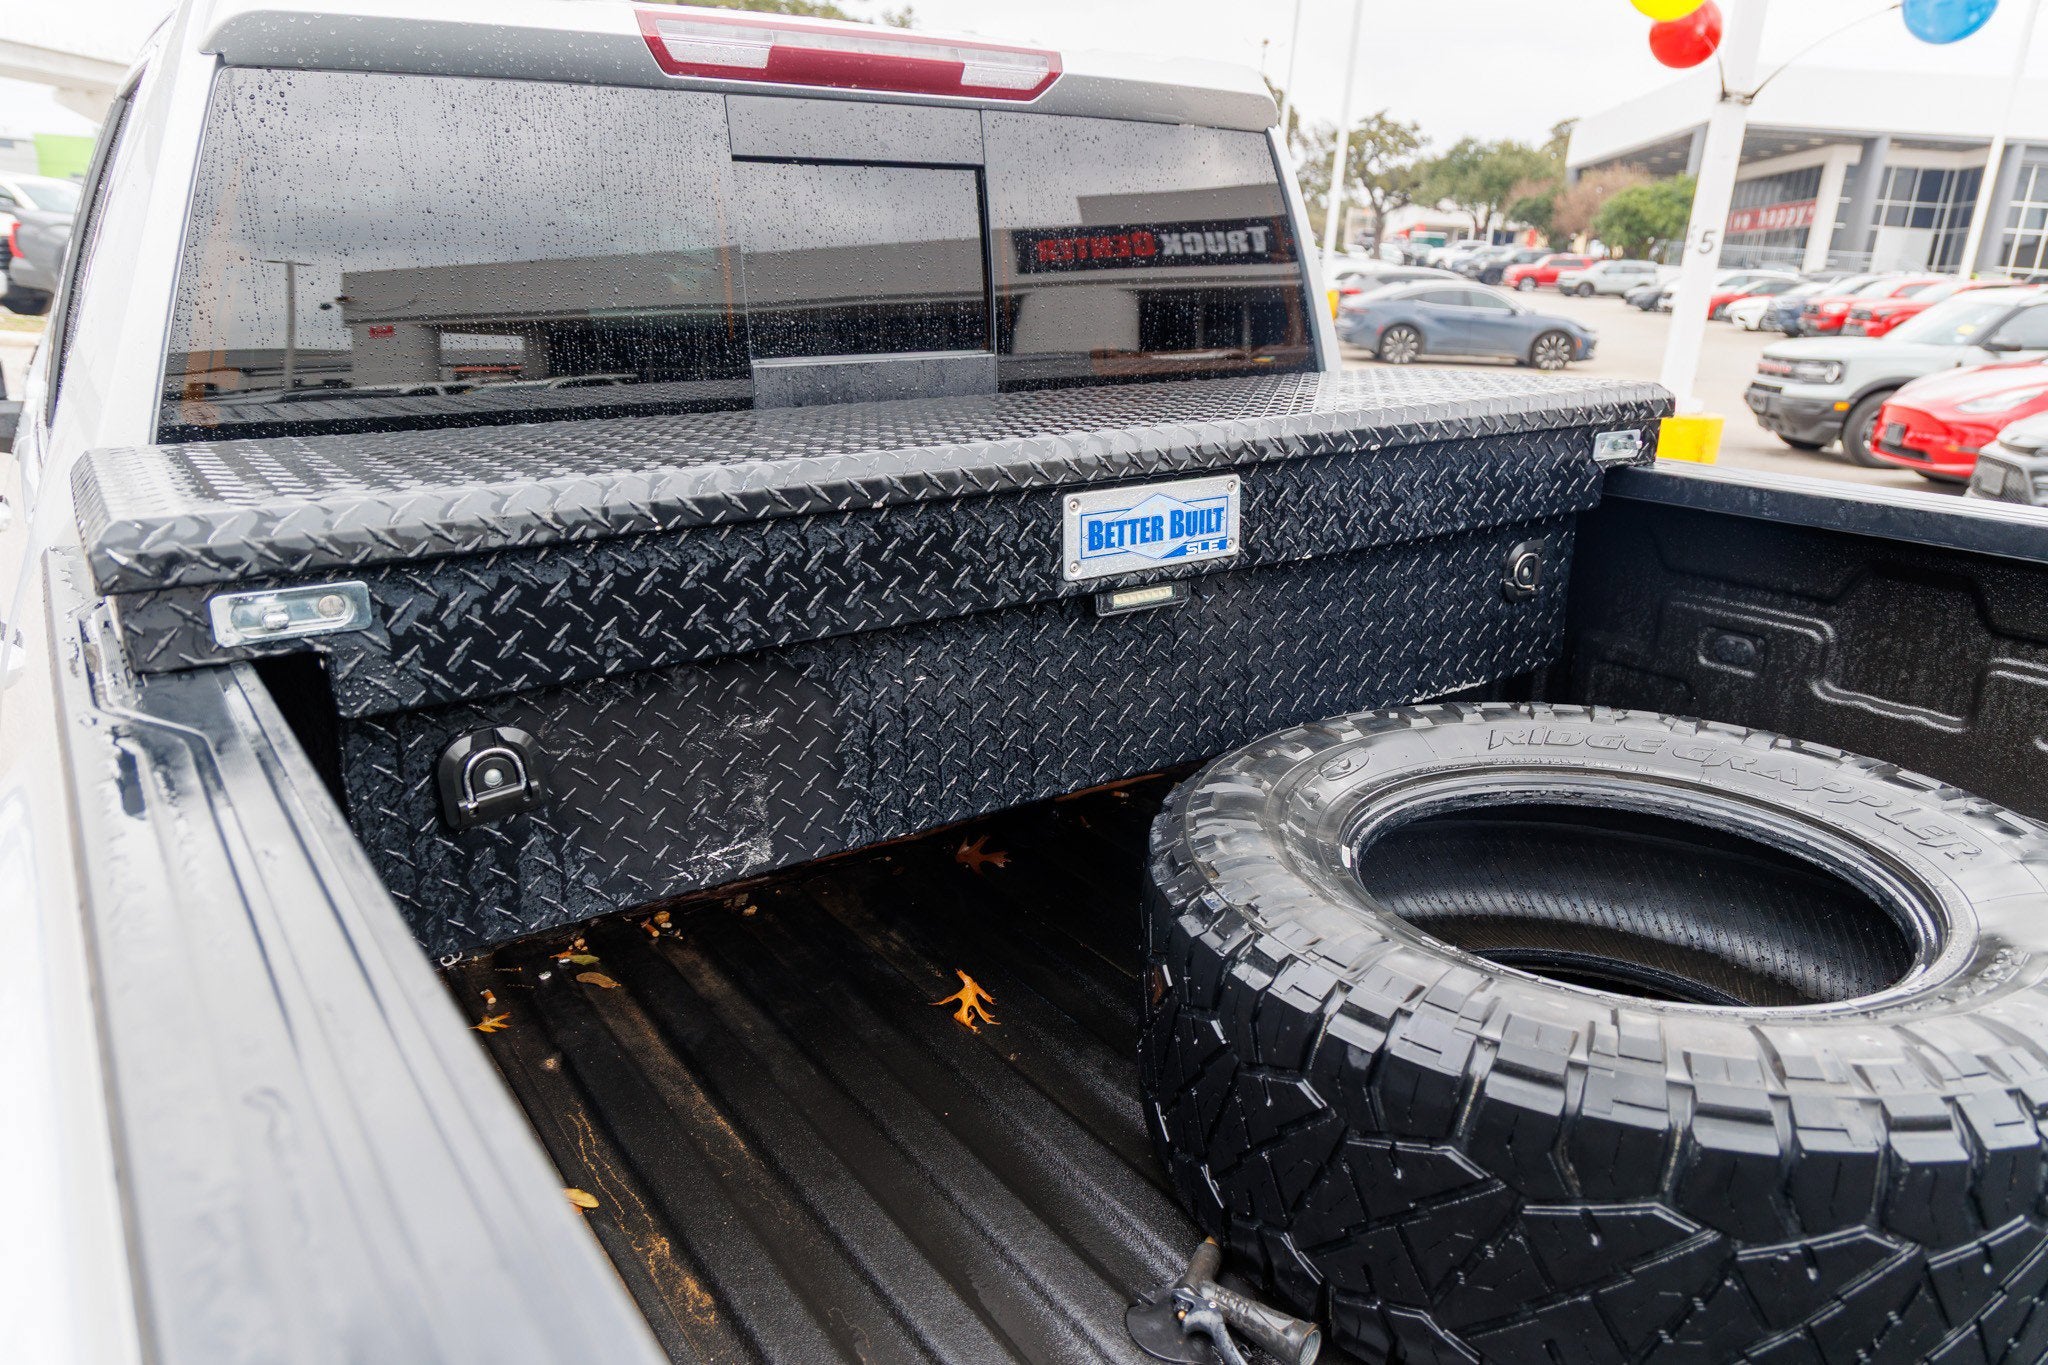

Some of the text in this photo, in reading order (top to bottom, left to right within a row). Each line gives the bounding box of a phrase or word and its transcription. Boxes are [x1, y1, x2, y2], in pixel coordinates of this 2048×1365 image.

[1088, 508, 1225, 552] BETTER BUILT
[1186, 541, 1220, 555] SLE
[1487, 725, 1667, 755] RIDGE
[1672, 747, 1982, 859] GRAPPLER
